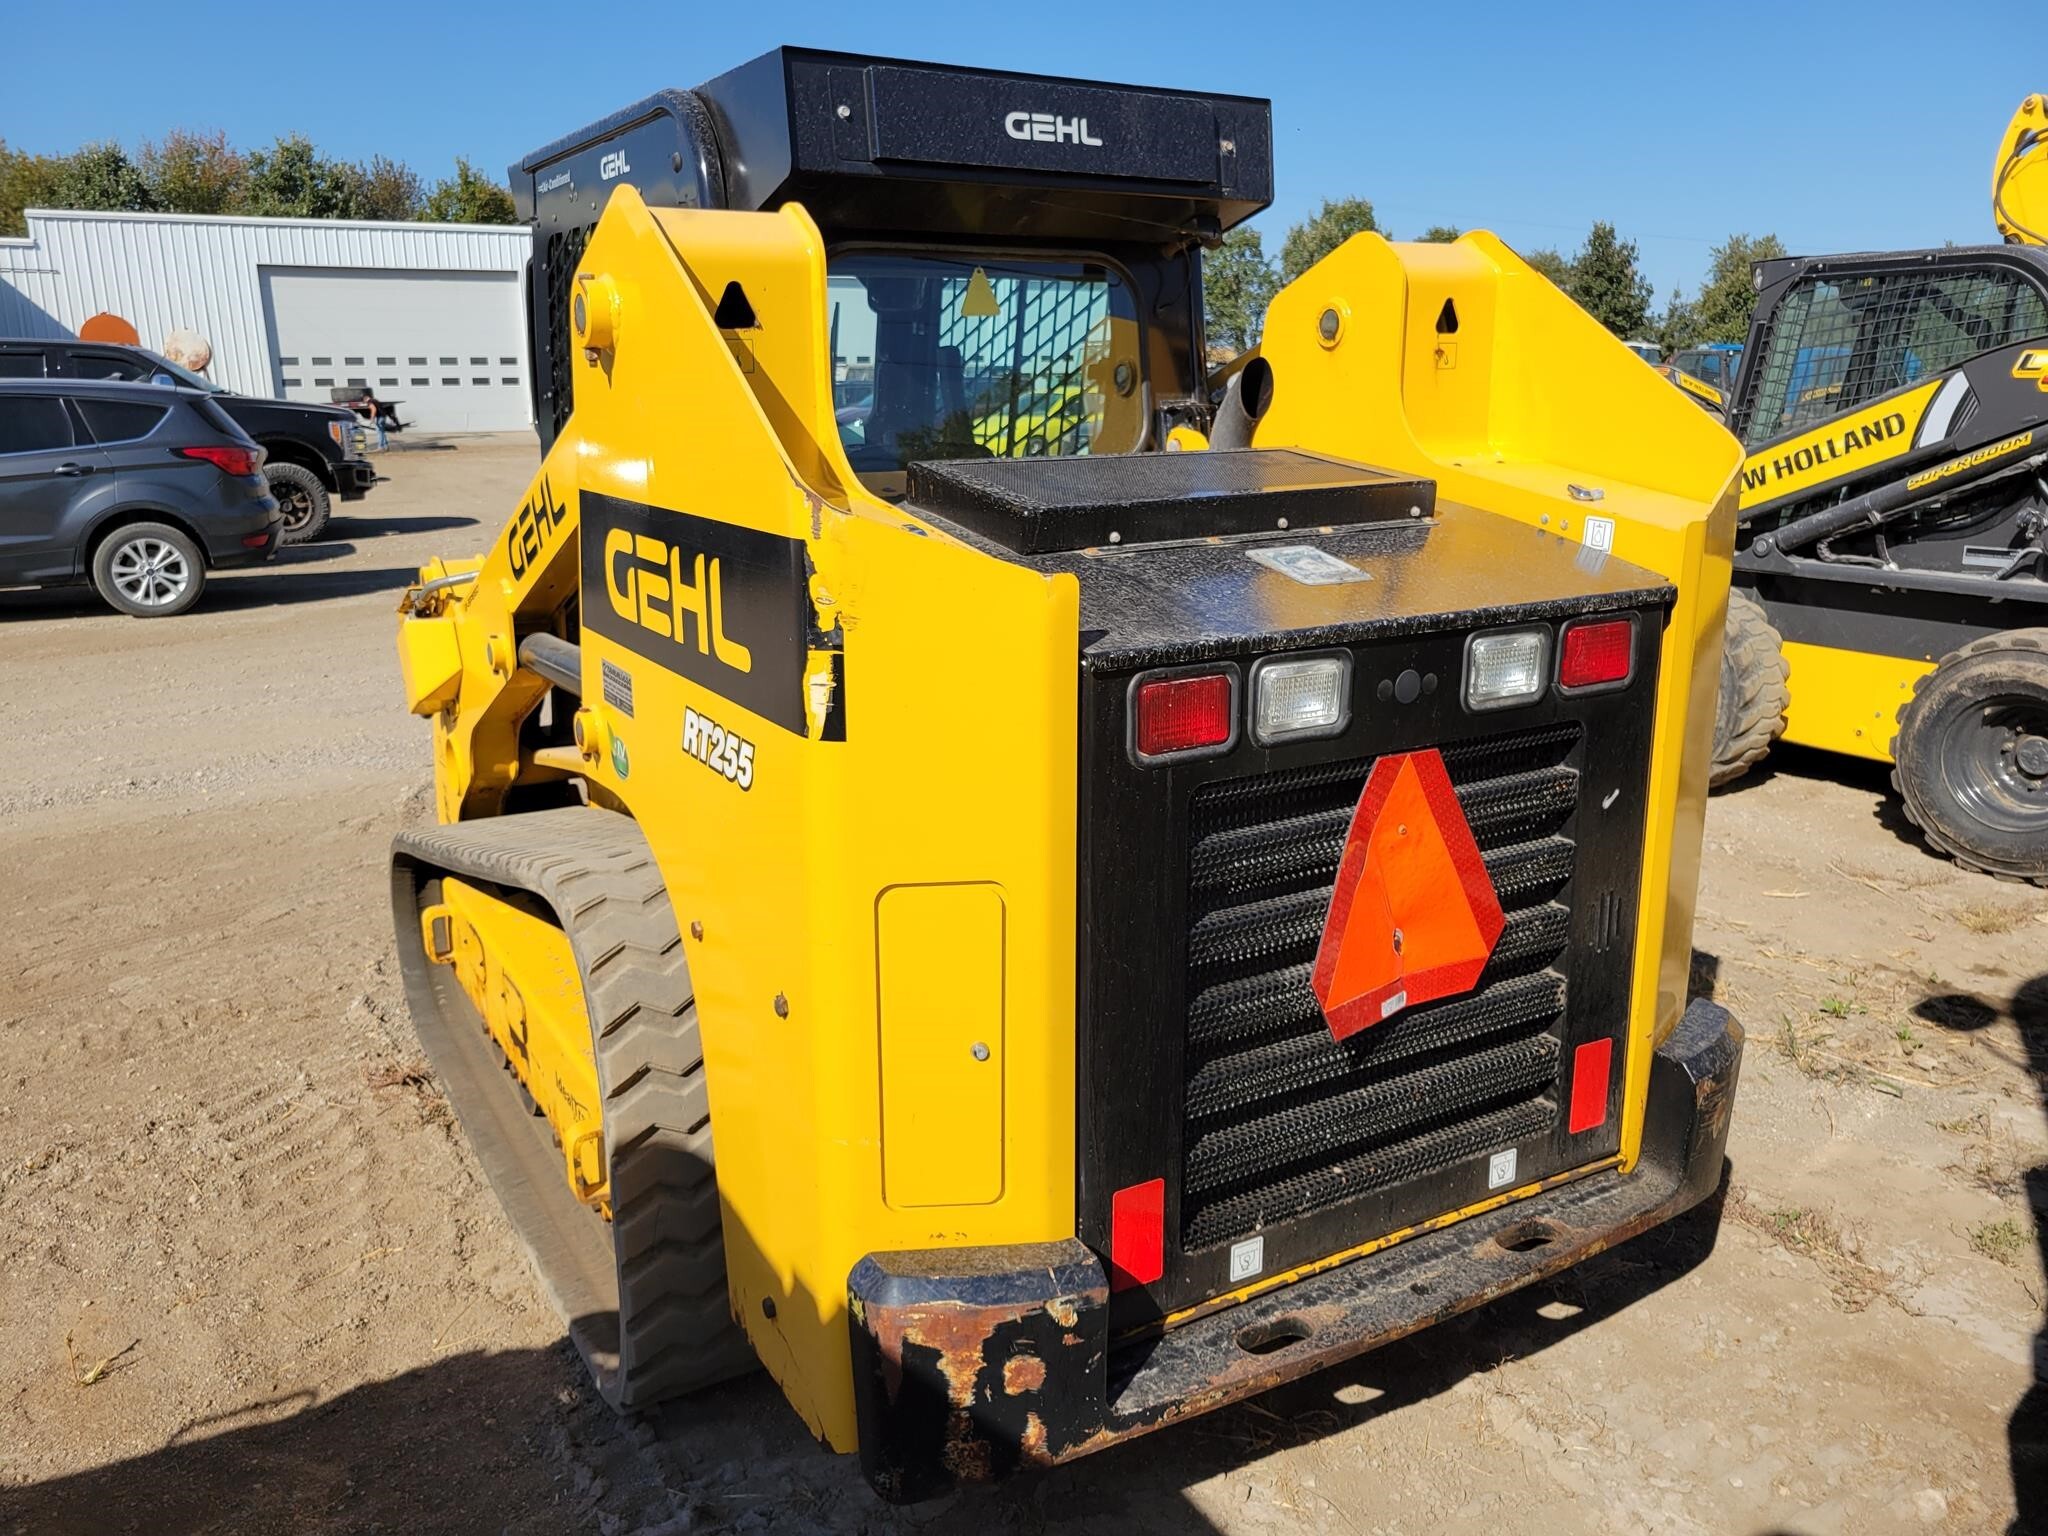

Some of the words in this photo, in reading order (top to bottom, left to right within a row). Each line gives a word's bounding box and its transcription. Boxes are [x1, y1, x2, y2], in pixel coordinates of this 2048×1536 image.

[1005, 111, 1103, 147] GEHL
[600, 149, 630, 180] GEHL
[1773, 412, 1906, 480] HOLLAND
[1973, 433, 2031, 463] BOOM
[507, 471, 566, 582] GEHL
[604, 527, 752, 674] GEHL
[682, 705, 756, 792] RT255
